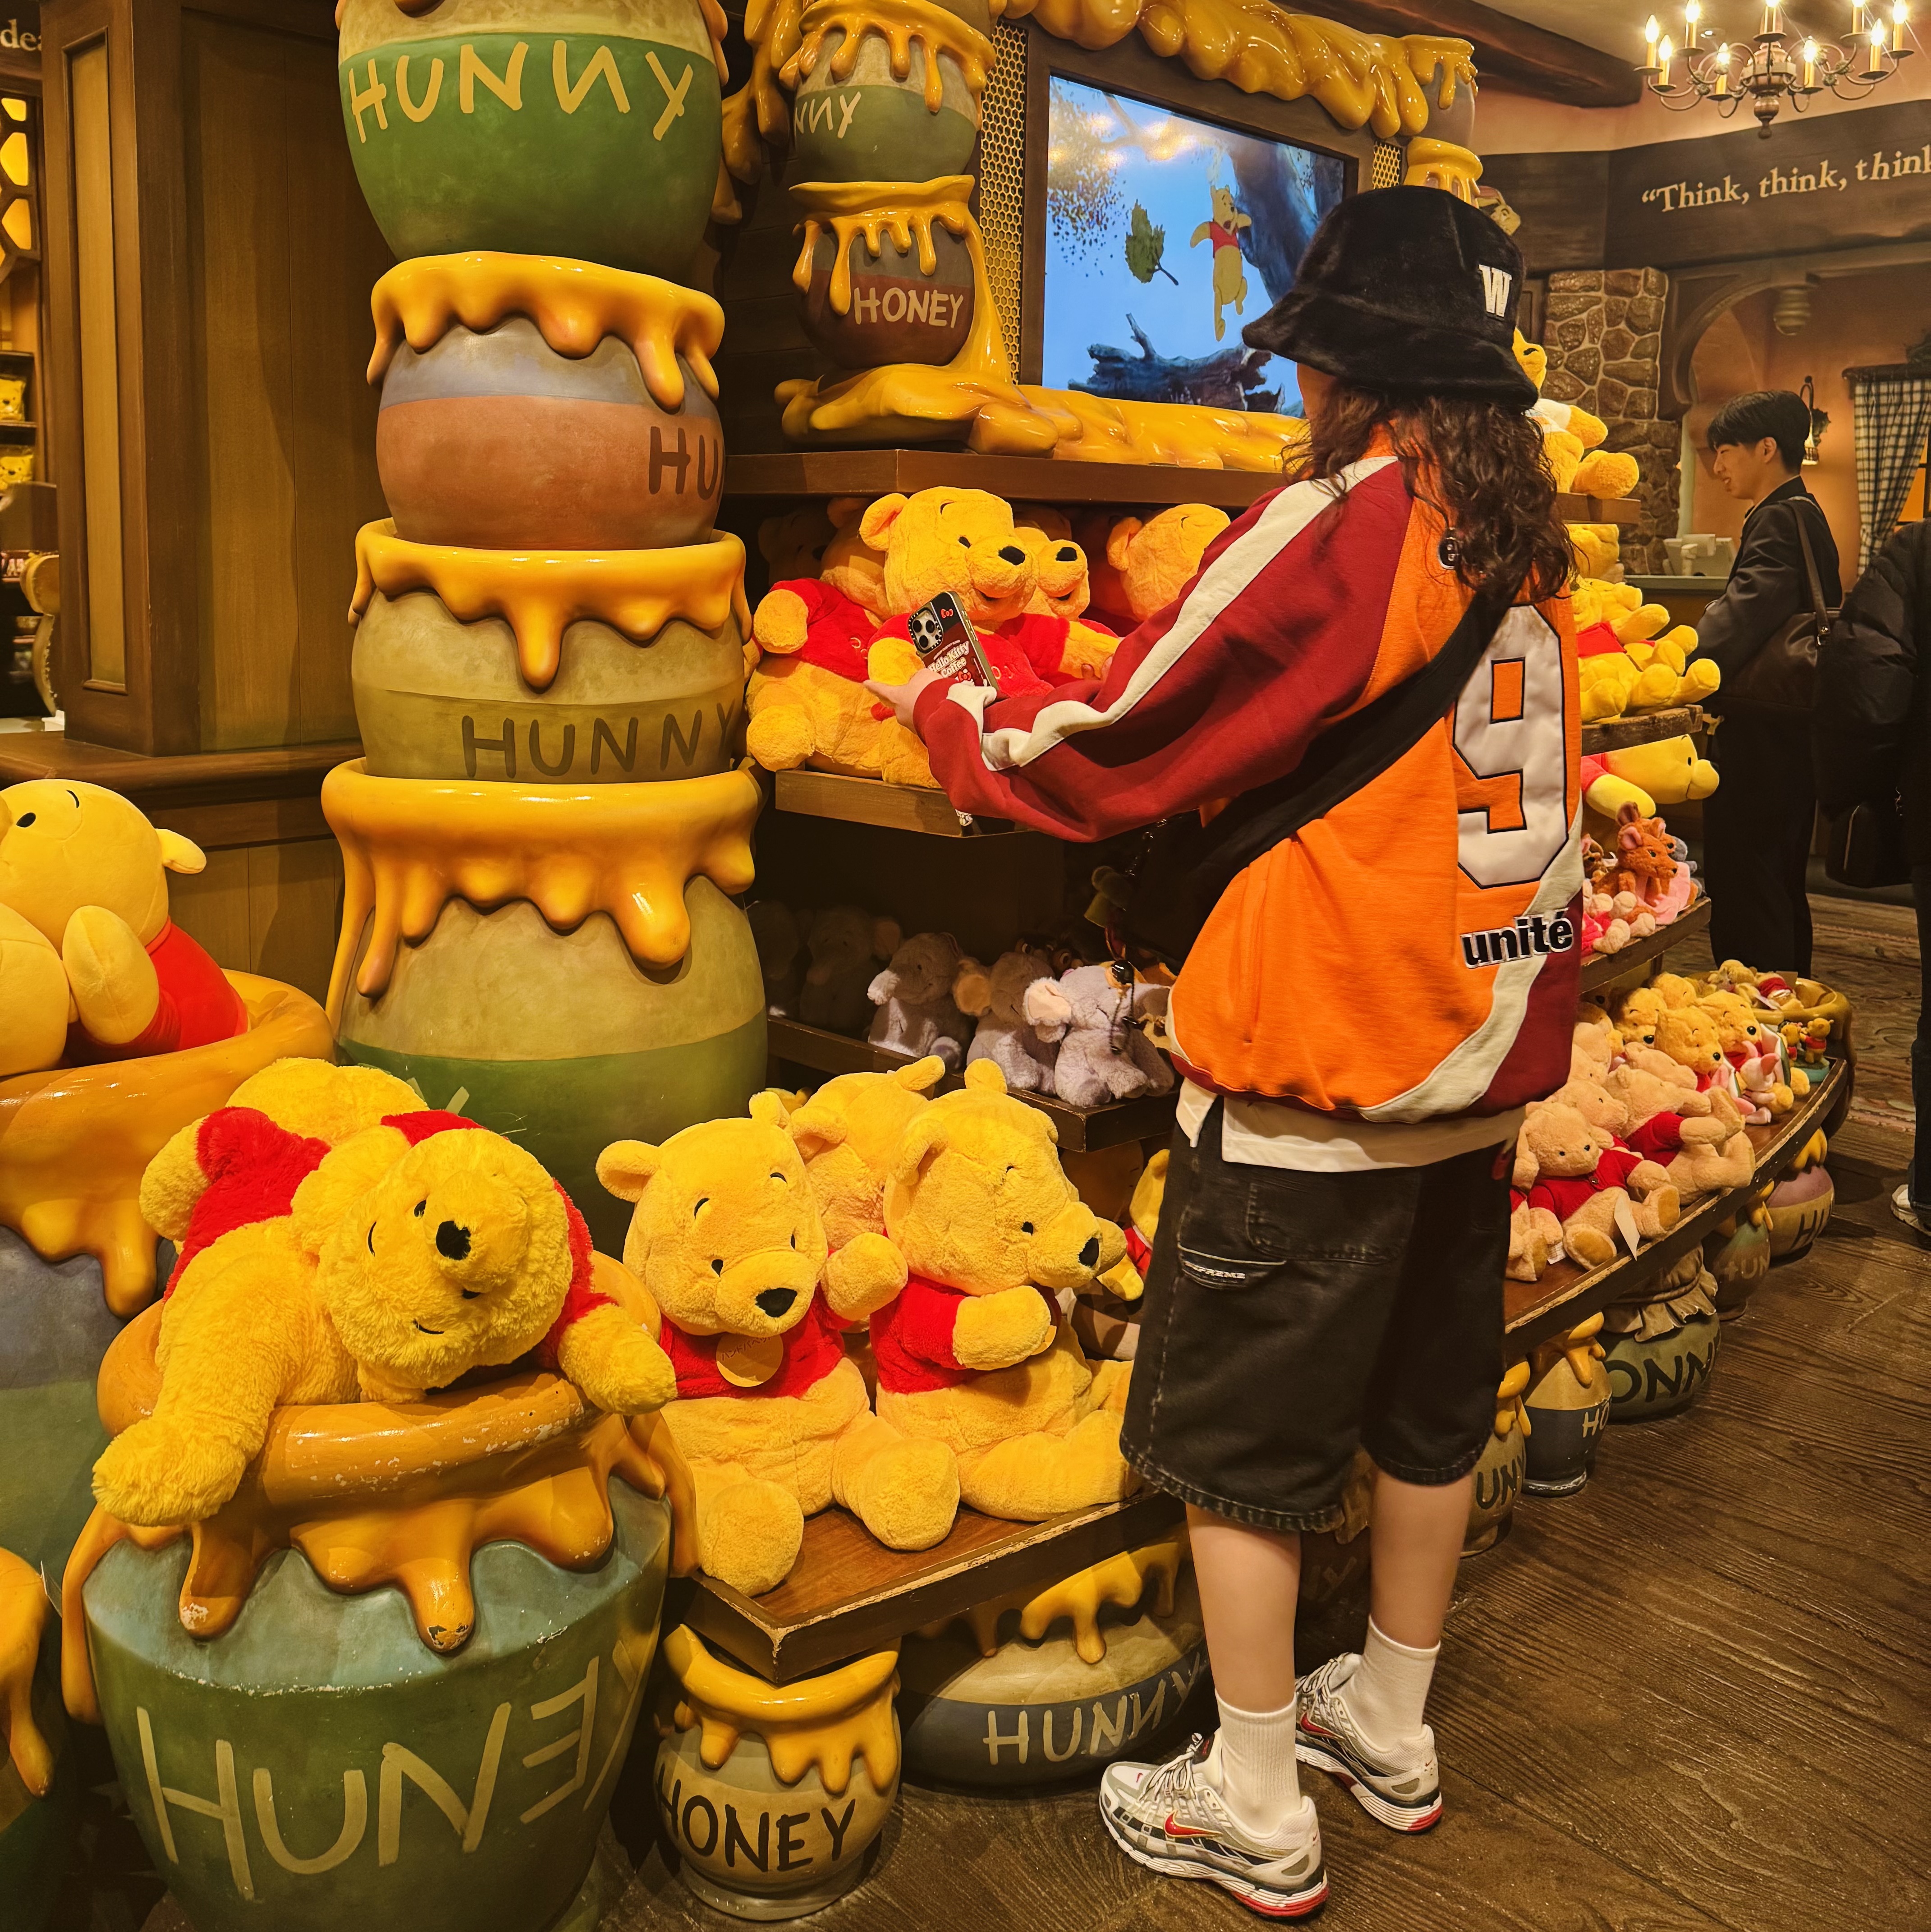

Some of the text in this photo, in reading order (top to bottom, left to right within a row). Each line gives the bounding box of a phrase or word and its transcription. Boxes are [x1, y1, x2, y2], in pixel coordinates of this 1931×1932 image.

[1759, 159, 1847, 197] think,
[854, 287, 964, 328] HONEY
[1478, 264, 1512, 317] W
[648, 426, 724, 503] HU
[461, 698, 735, 779] HUNNY
[1453, 604, 1569, 890] 9
[1460, 907, 1574, 968] unité
[655, 1762, 856, 1872] HONEY
